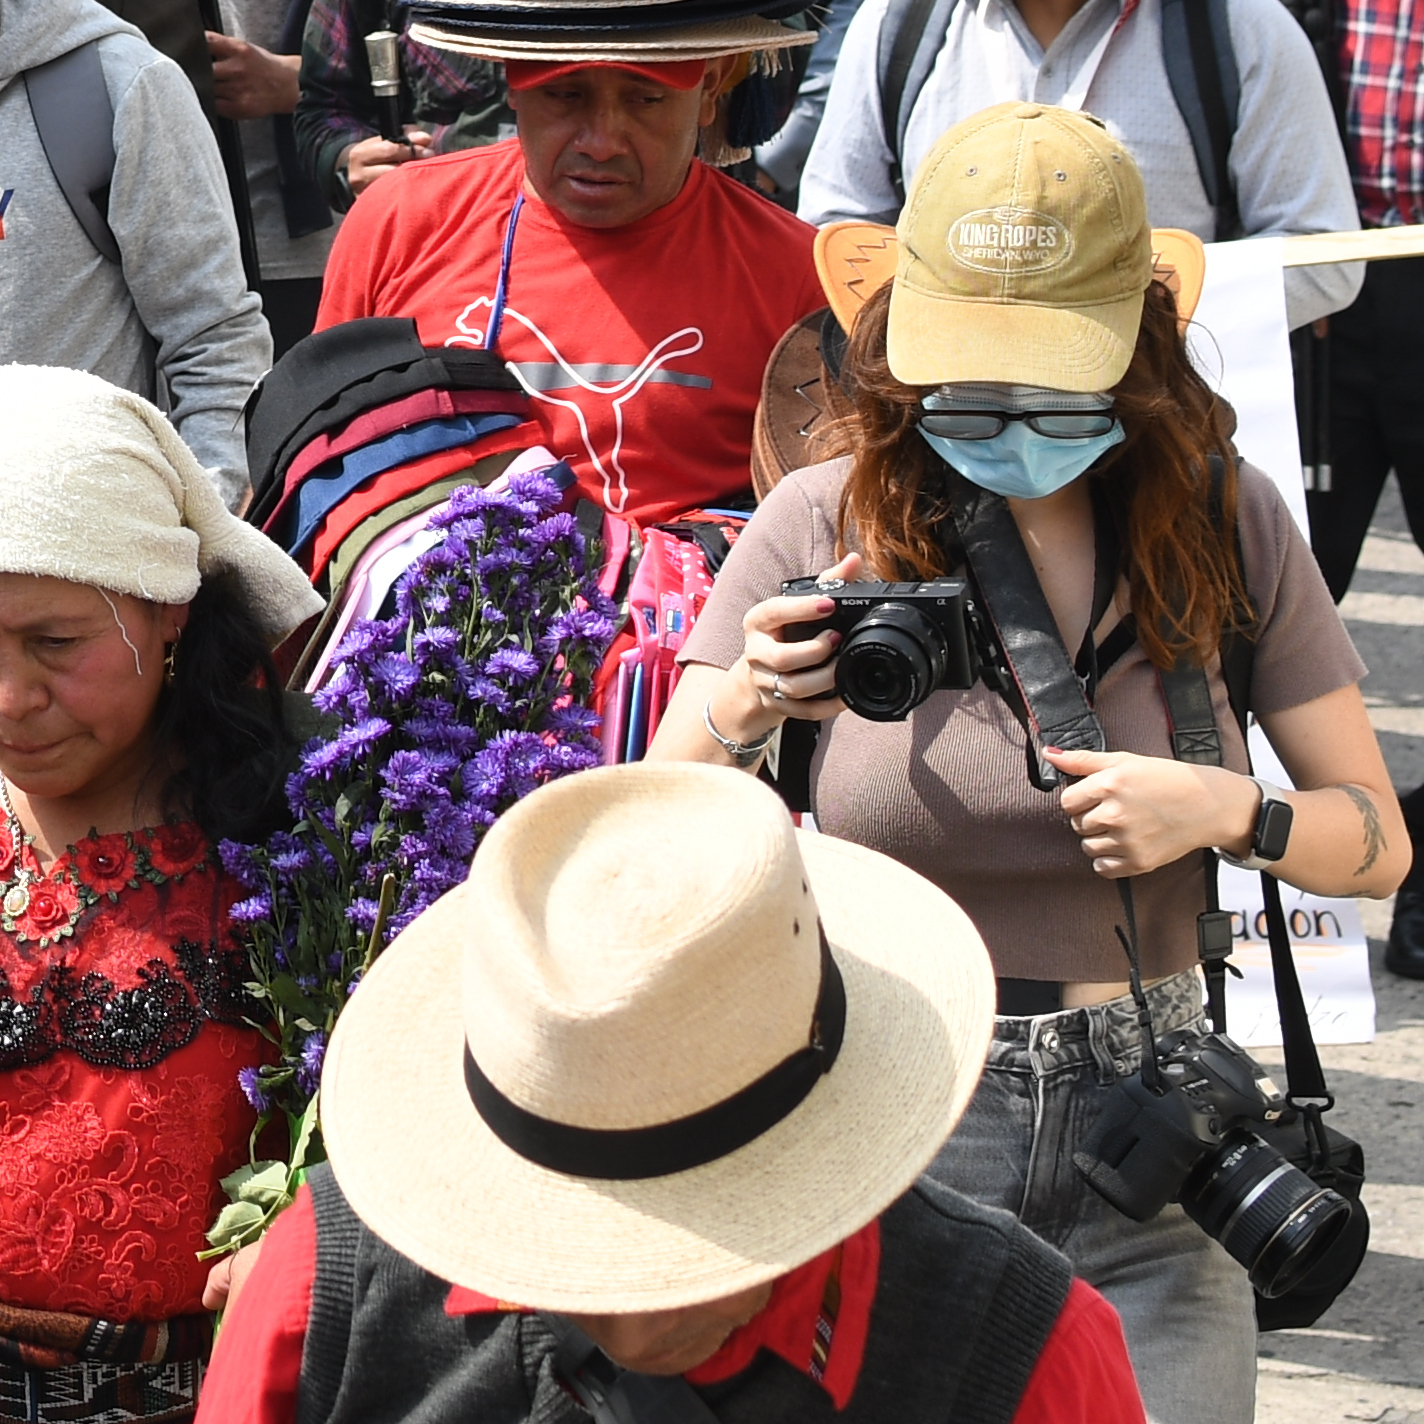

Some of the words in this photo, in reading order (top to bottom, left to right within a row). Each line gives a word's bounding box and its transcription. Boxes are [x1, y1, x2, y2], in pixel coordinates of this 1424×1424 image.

[958, 222, 999, 247] KING
[1000, 224, 1057, 247] ROPES
[841, 598, 871, 606] SONY
